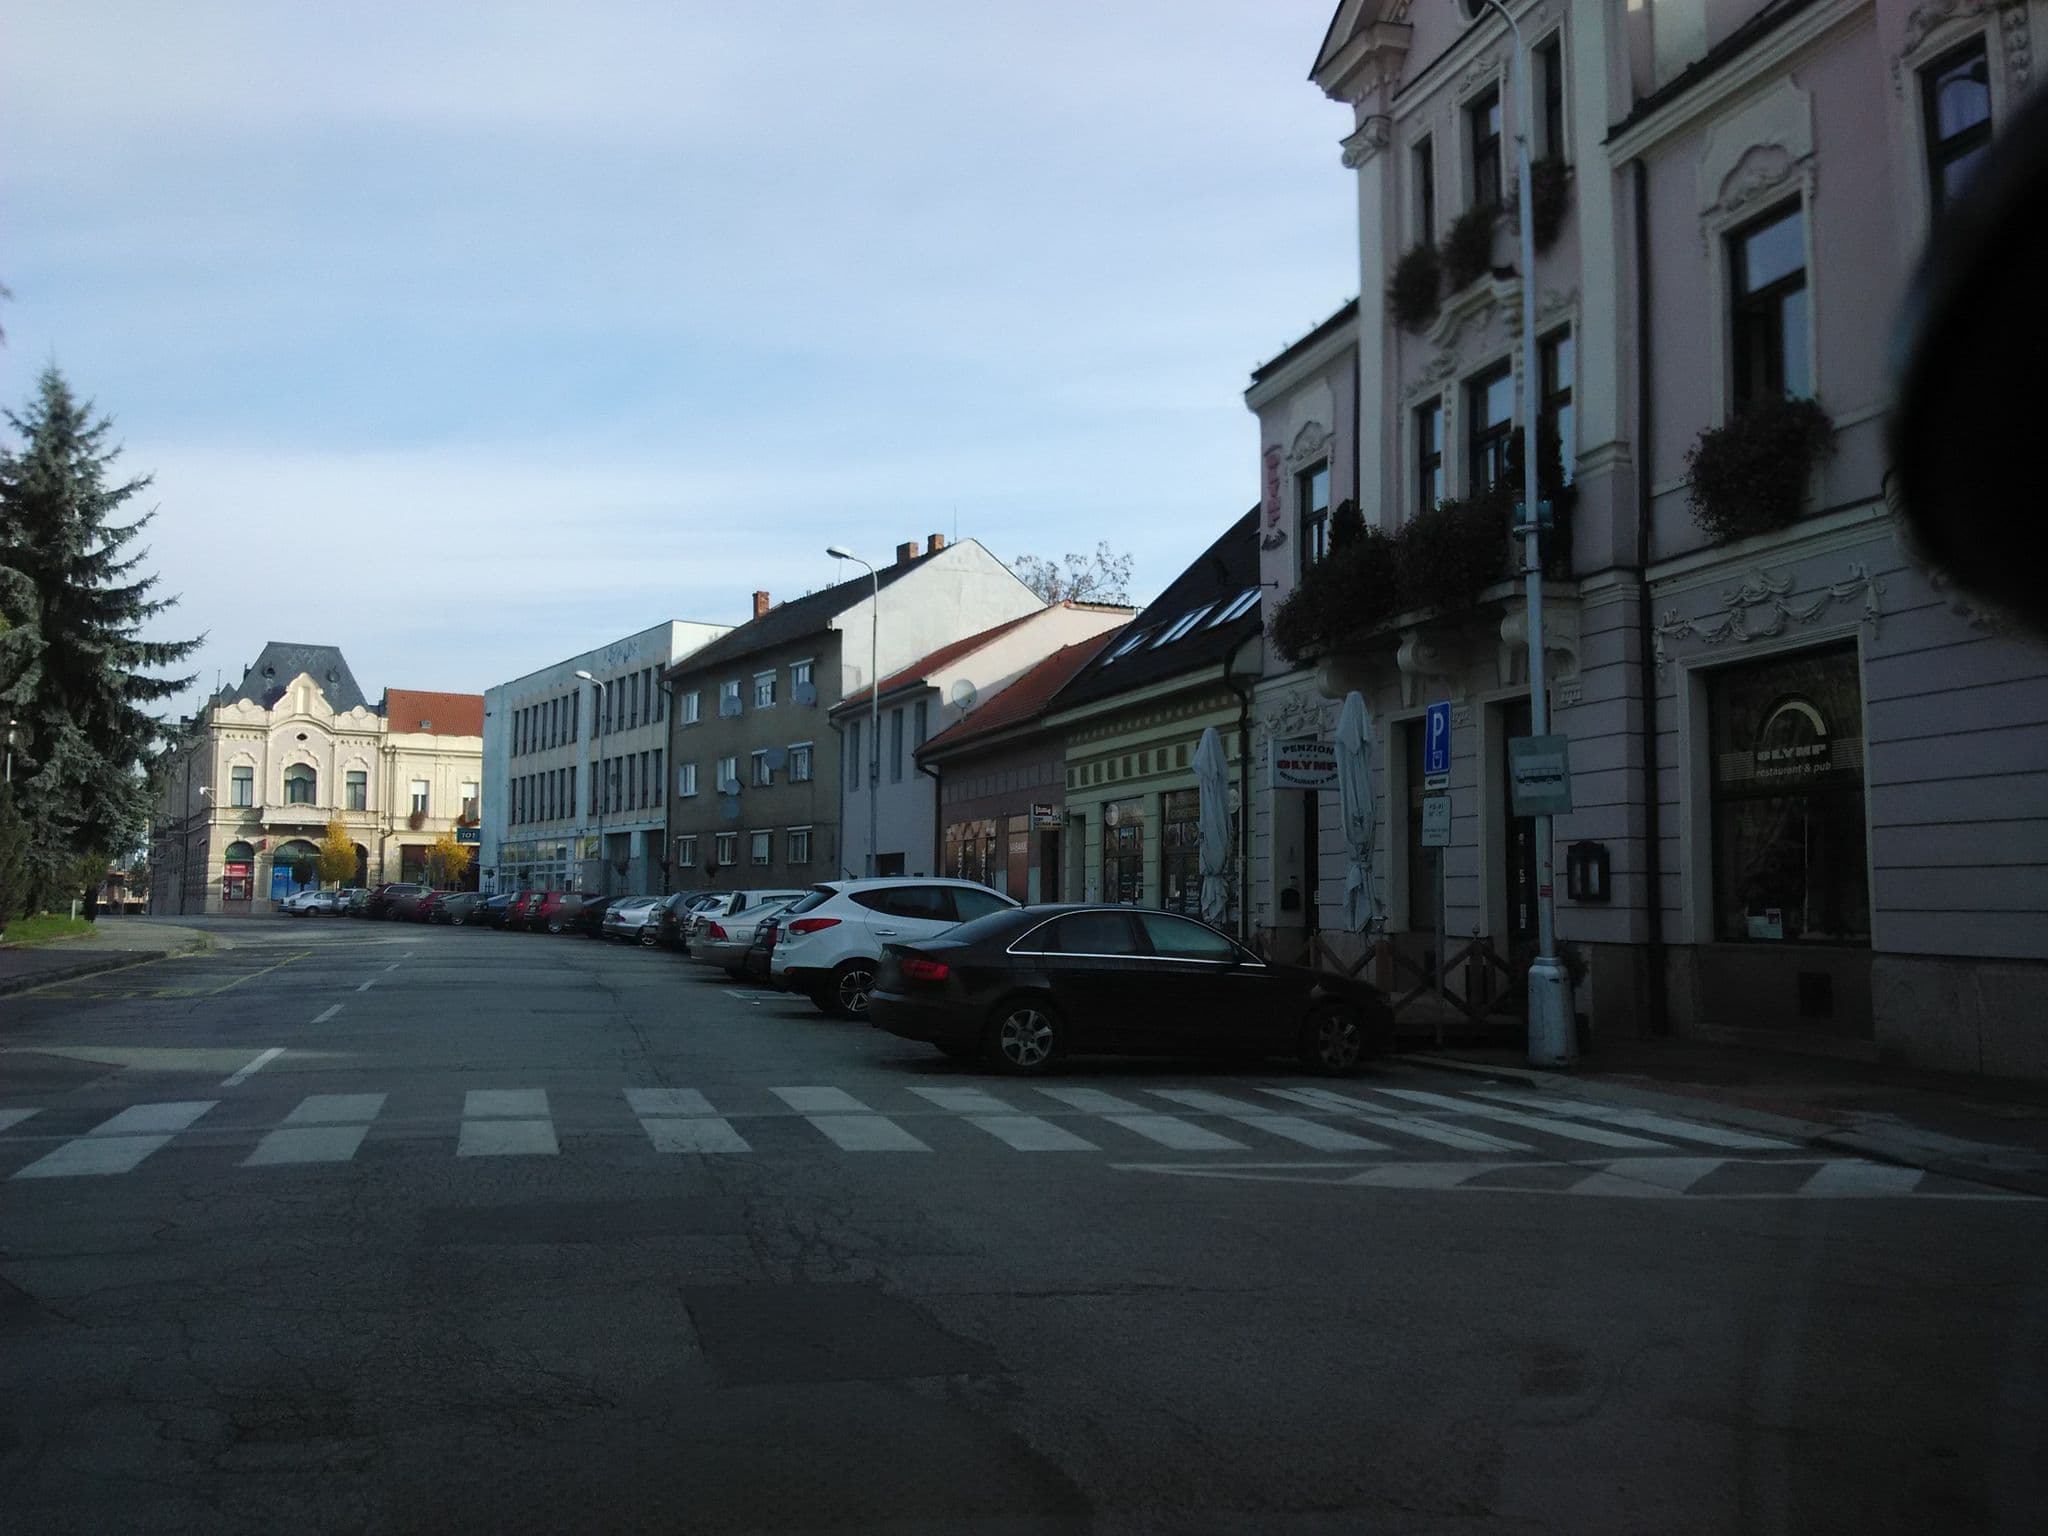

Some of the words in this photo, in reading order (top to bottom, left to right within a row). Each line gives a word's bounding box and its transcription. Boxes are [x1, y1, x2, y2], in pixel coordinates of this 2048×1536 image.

[1432, 712, 1444, 750] P
[1282, 744, 1335, 755] PENZION
[1757, 744, 1826, 760] OLYMP
[1277, 759, 1338, 771] OLYMP
[1757, 764, 1802, 776] restaurant
[1813, 761, 1831, 775] pub
[1280, 771, 1319, 784] RESTAURANT
